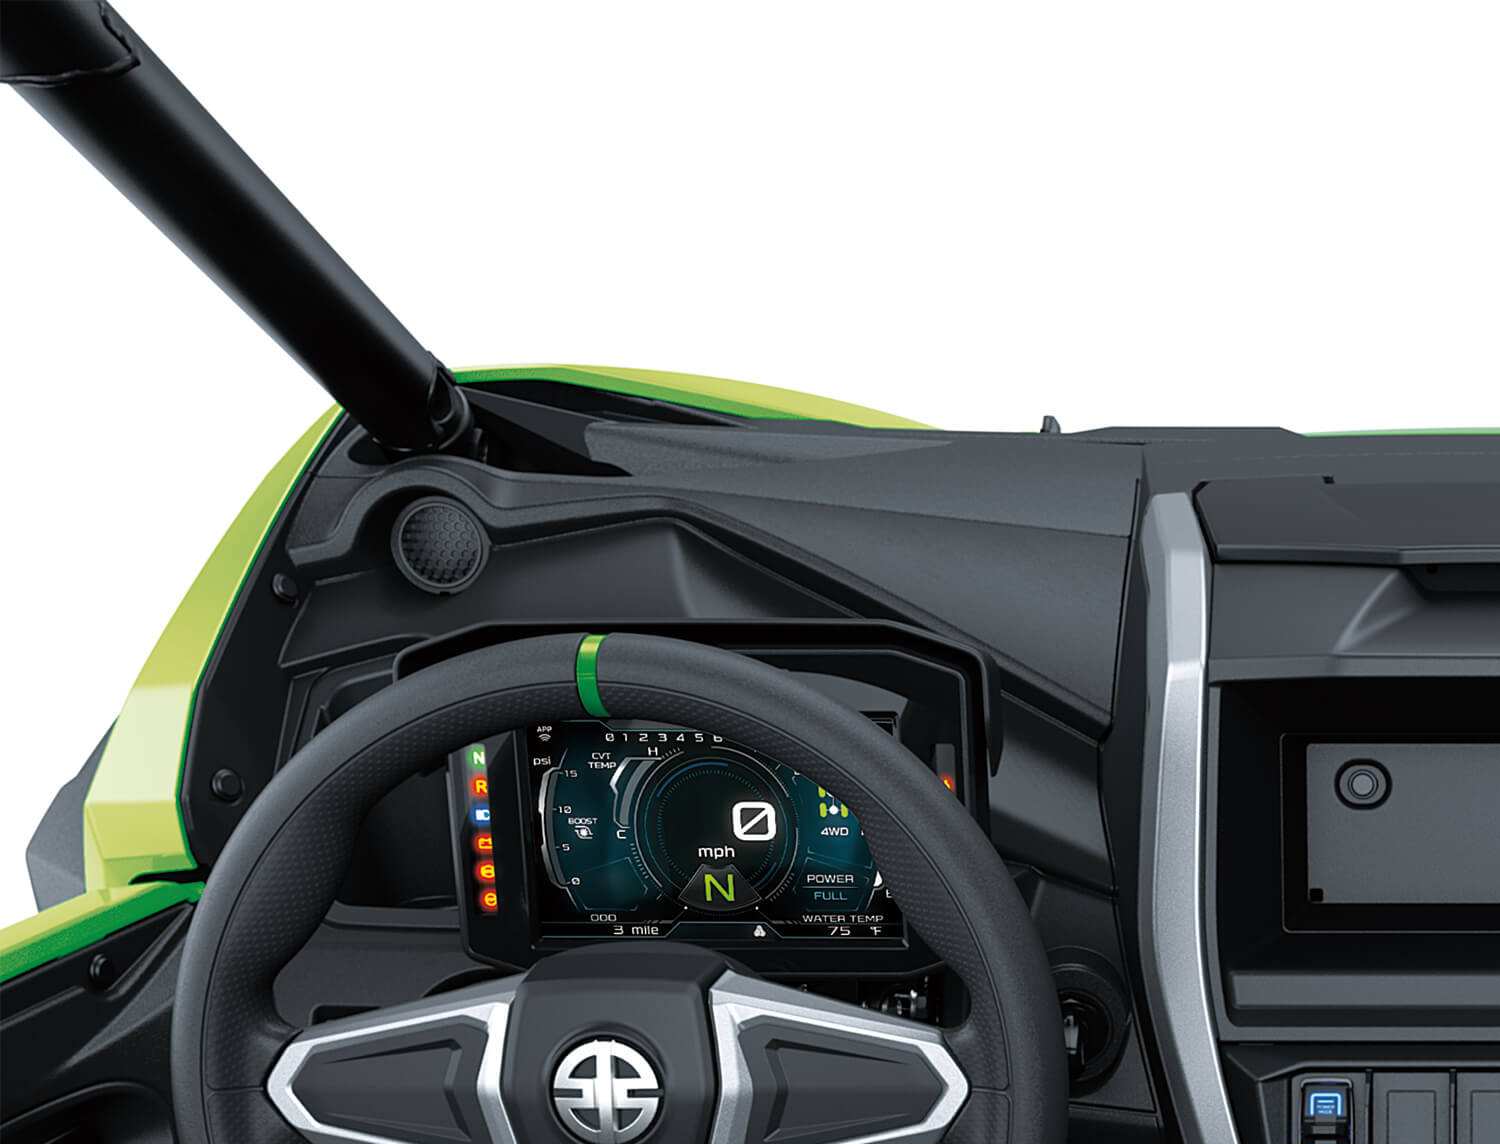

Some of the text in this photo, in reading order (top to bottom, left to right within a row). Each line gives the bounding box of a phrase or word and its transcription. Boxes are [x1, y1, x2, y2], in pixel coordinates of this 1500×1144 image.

[536, 725, 553, 733] APP
[622, 732, 628, 742] 1
[638, 733, 649, 742] 2
[657, 733, 668, 742] 3
[676, 733, 685, 742] 4
[694, 733, 704, 743] 5
[591, 752, 611, 760] CVT
[647, 746, 658, 756] H
[473, 752, 486, 764] N
[533, 756, 551, 766] psi
[588, 761, 617, 769] TEMP
[564, 769, 578, 778] 15
[476, 780, 488, 792] R
[568, 817, 597, 825] BOOST
[616, 829, 627, 840] C
[820, 826, 849, 836] 4WD
[562, 843, 570, 851] 5
[698, 845, 735, 860] mph
[806, 874, 854, 884] POWER
[705, 874, 734, 901] N
[814, 891, 848, 901] FULL
[802, 914, 884, 923] WATER TEMP
[613, 925, 659, 935] 3 mile
[828, 926, 851, 936] 75
